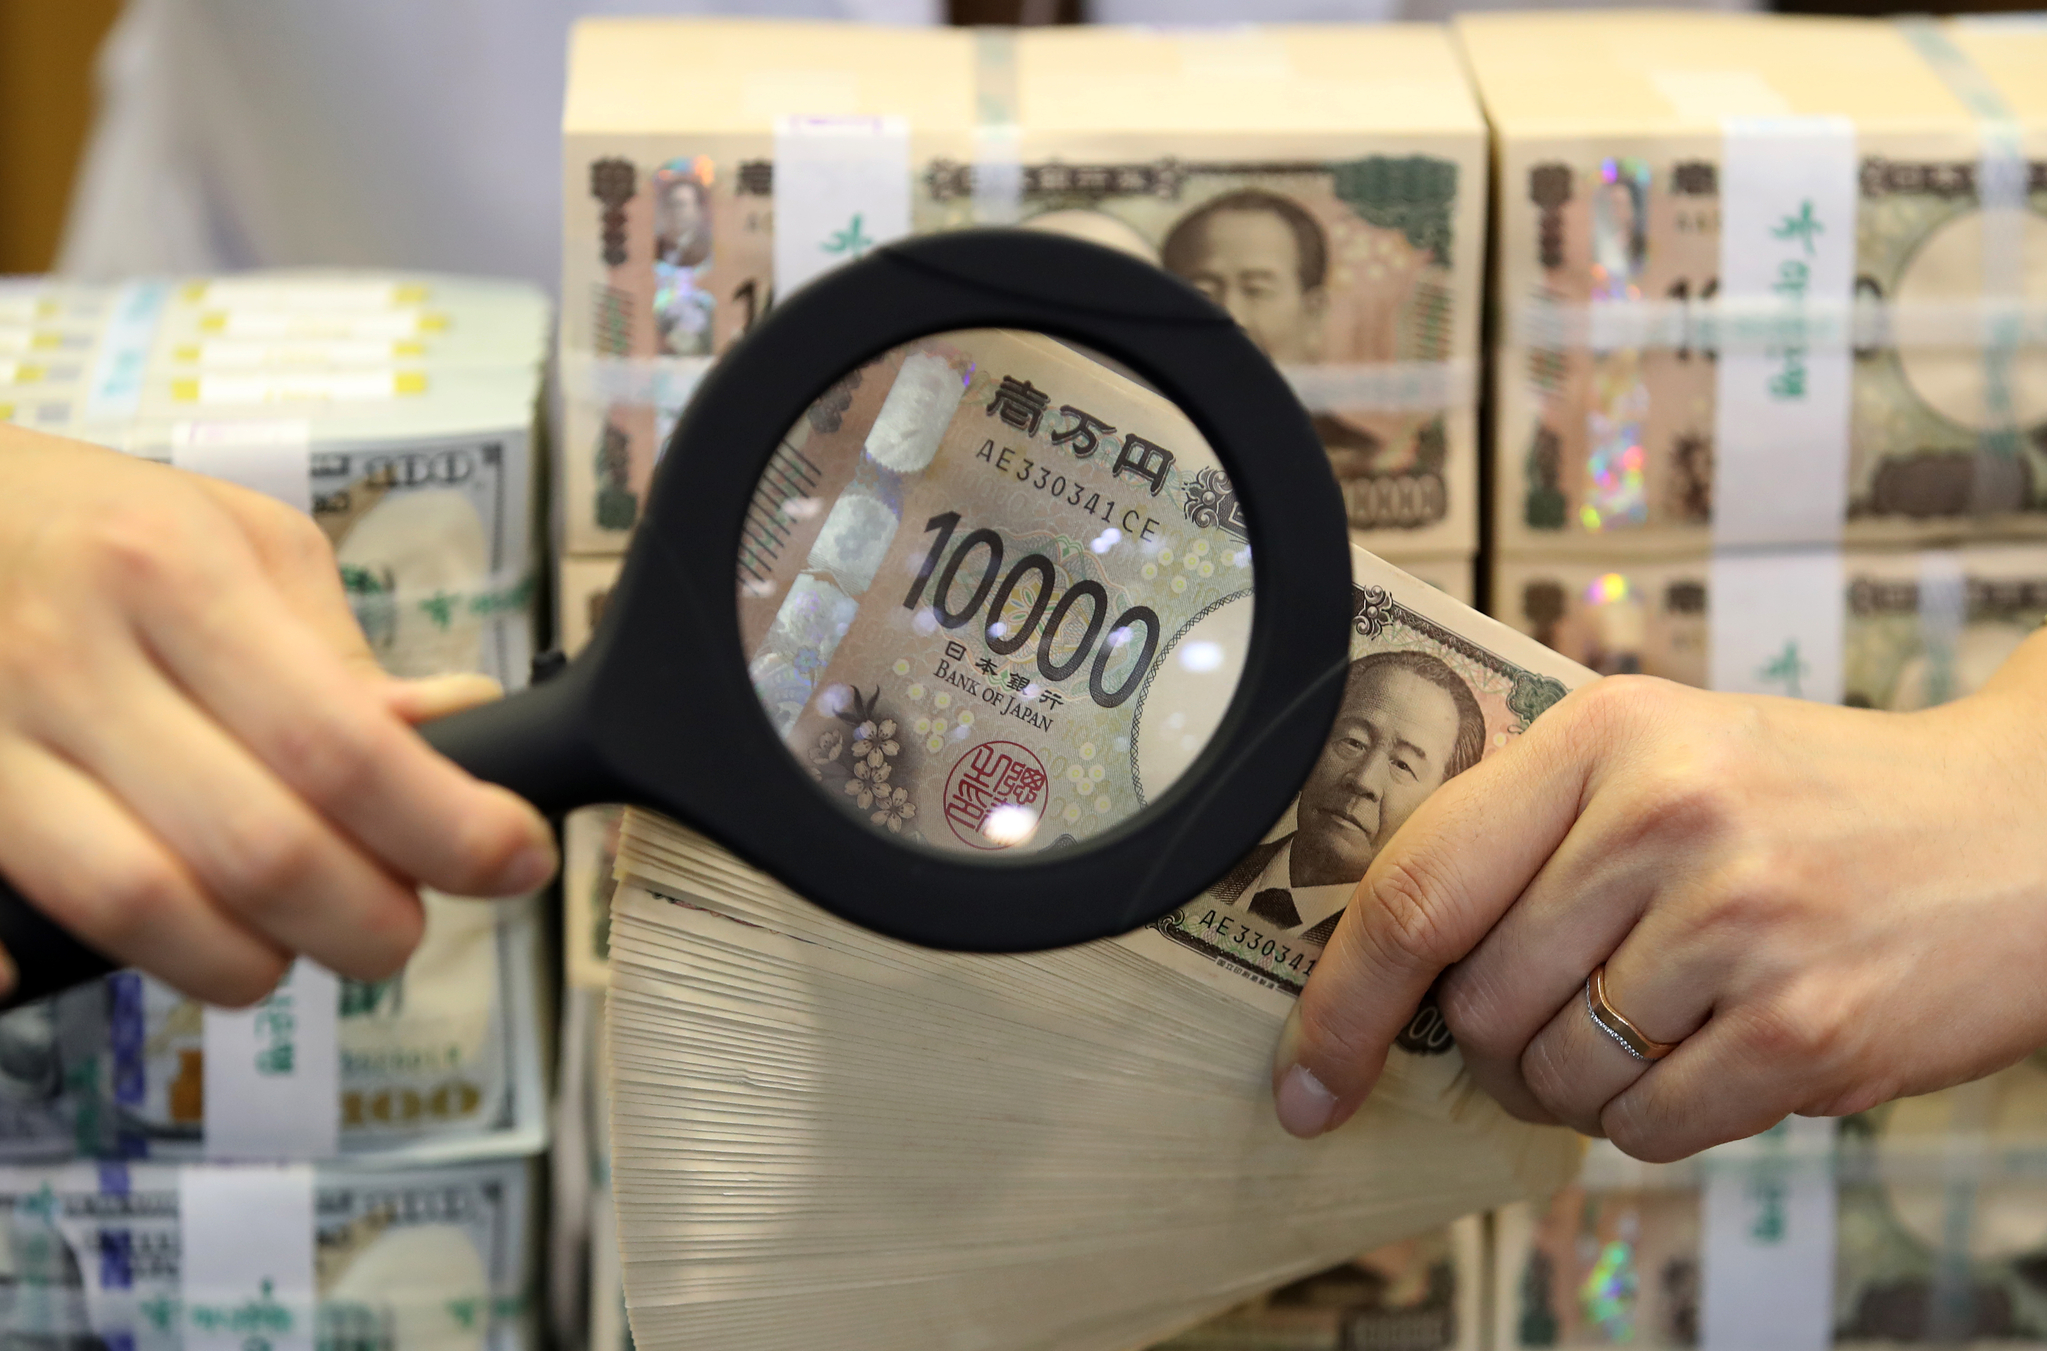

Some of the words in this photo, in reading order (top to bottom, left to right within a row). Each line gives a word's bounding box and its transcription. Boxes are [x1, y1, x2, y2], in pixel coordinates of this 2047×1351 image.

[976, 439, 1160, 543] AE330341CE
[902, 510, 1160, 709] 10000
[933, 659, 981, 696] BANK
[981, 687, 1005, 707] OF
[1000, 695, 1054, 733] JAPAN
[945, 641, 1064, 710] 日本銀行
